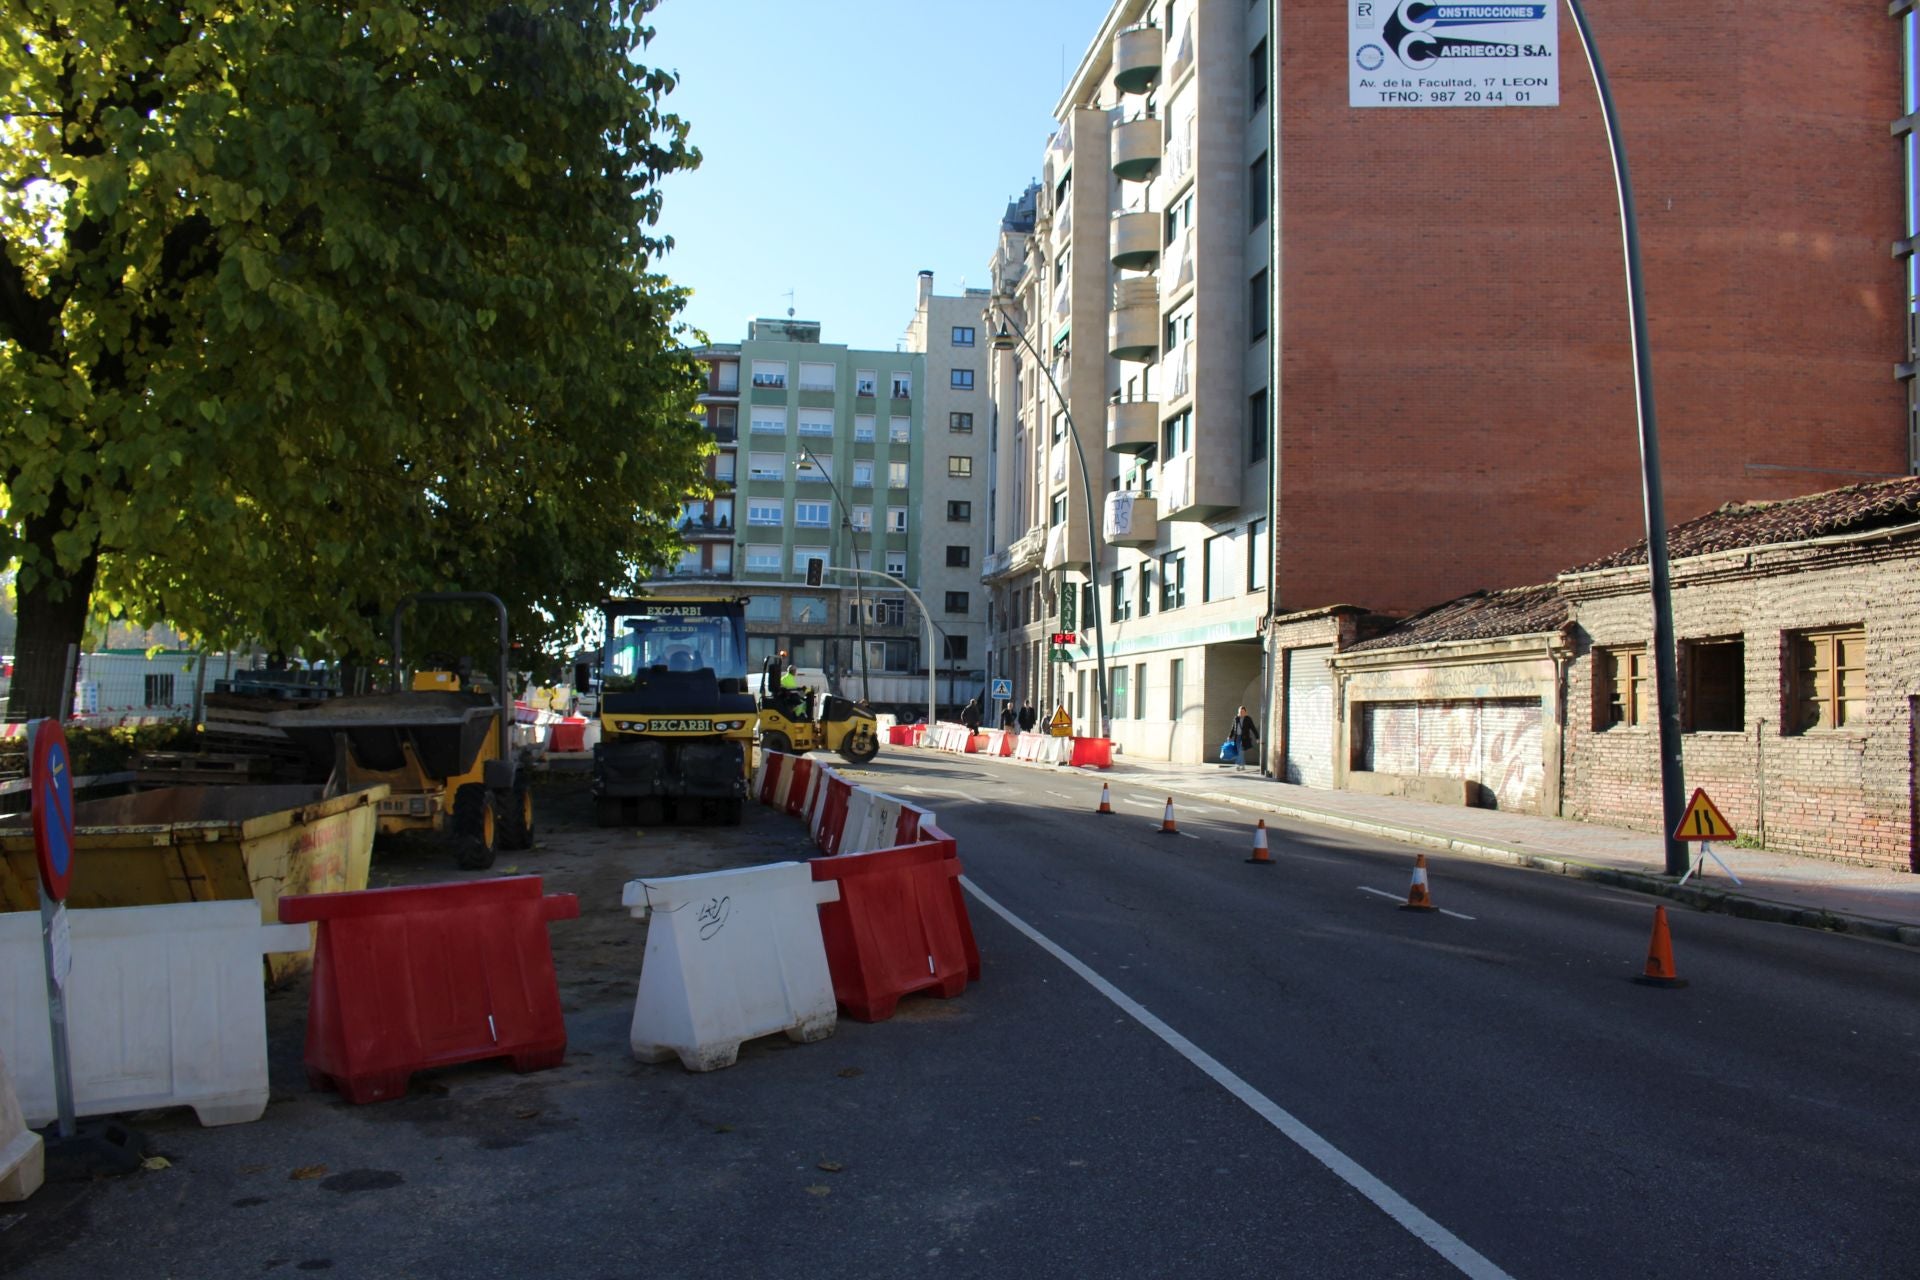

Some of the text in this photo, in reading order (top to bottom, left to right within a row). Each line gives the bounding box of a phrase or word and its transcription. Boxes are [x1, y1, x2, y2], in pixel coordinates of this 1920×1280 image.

[1523, 45, 1551, 57] S.A.
[1359, 80, 1376, 88] Av.
[1383, 79, 1398, 88] de
[1401, 79, 1412, 88] la
[1484, 78, 1496, 87] 17
[1502, 78, 1548, 87] LEON
[1379, 91, 1531, 102] TFNO: 987 20 44 01
[647, 606, 702, 616] EXCARBI
[1064, 583, 1074, 630] ASAJA
[650, 720, 711, 731] EXCARBI
